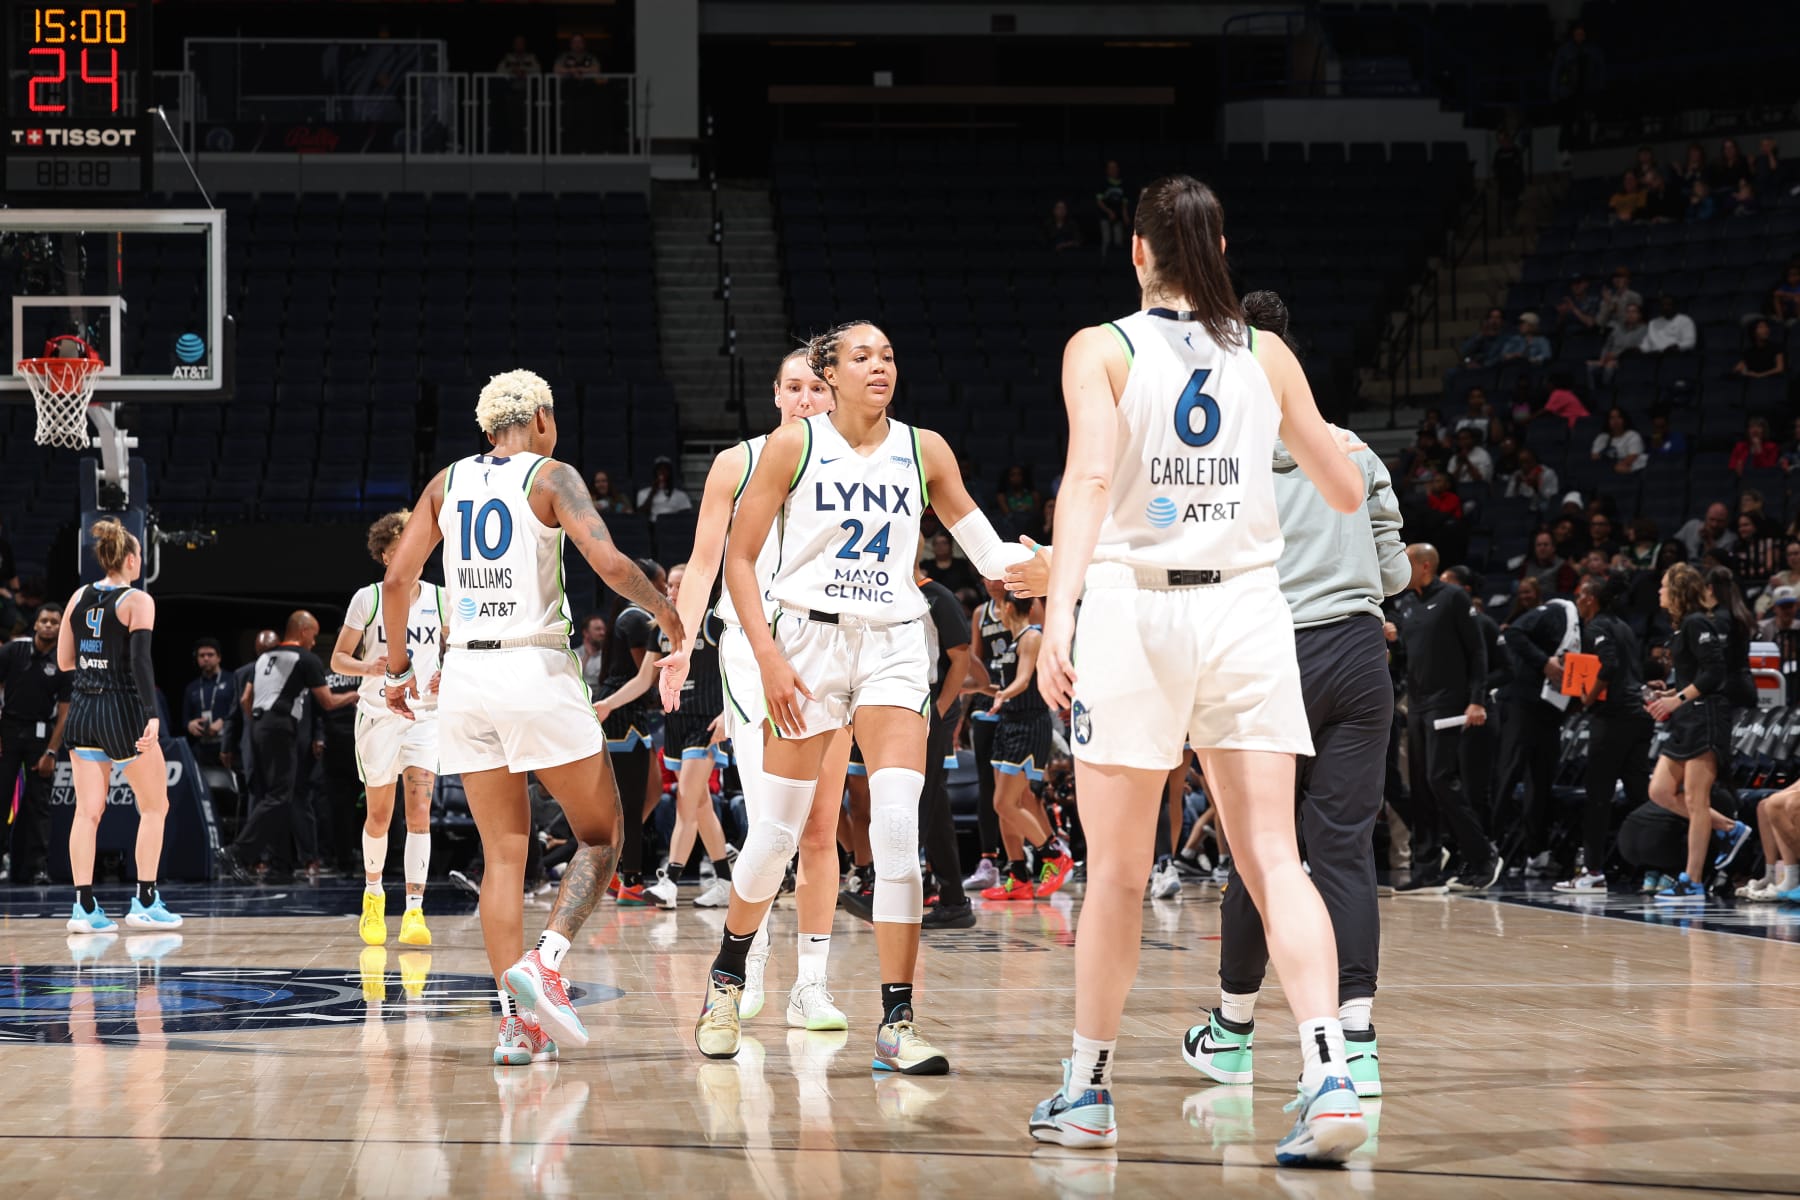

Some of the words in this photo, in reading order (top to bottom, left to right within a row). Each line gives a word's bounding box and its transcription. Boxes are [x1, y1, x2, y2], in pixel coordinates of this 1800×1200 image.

[35, 9, 126, 43] 15:00
[28, 48, 118, 112] 24
[45, 129, 136, 146] TISSOT
[172, 366, 208, 379] AT&T
[1174, 368, 1221, 448] 6
[1151, 457, 1239, 486] CARLETON
[815, 481, 911, 517] LYNX
[1182, 501, 1240, 523] AT&T
[457, 498, 513, 561] 10
[835, 518, 891, 562] 24
[457, 567, 513, 589] WILLIAMS
[834, 568, 889, 586] MAYO
[824, 583, 894, 603] CLINIC
[479, 601, 517, 617] AT&T
[86, 607, 105, 638] 4
[377, 625, 436, 644] LNX
[87, 658, 109, 669] AT&T
